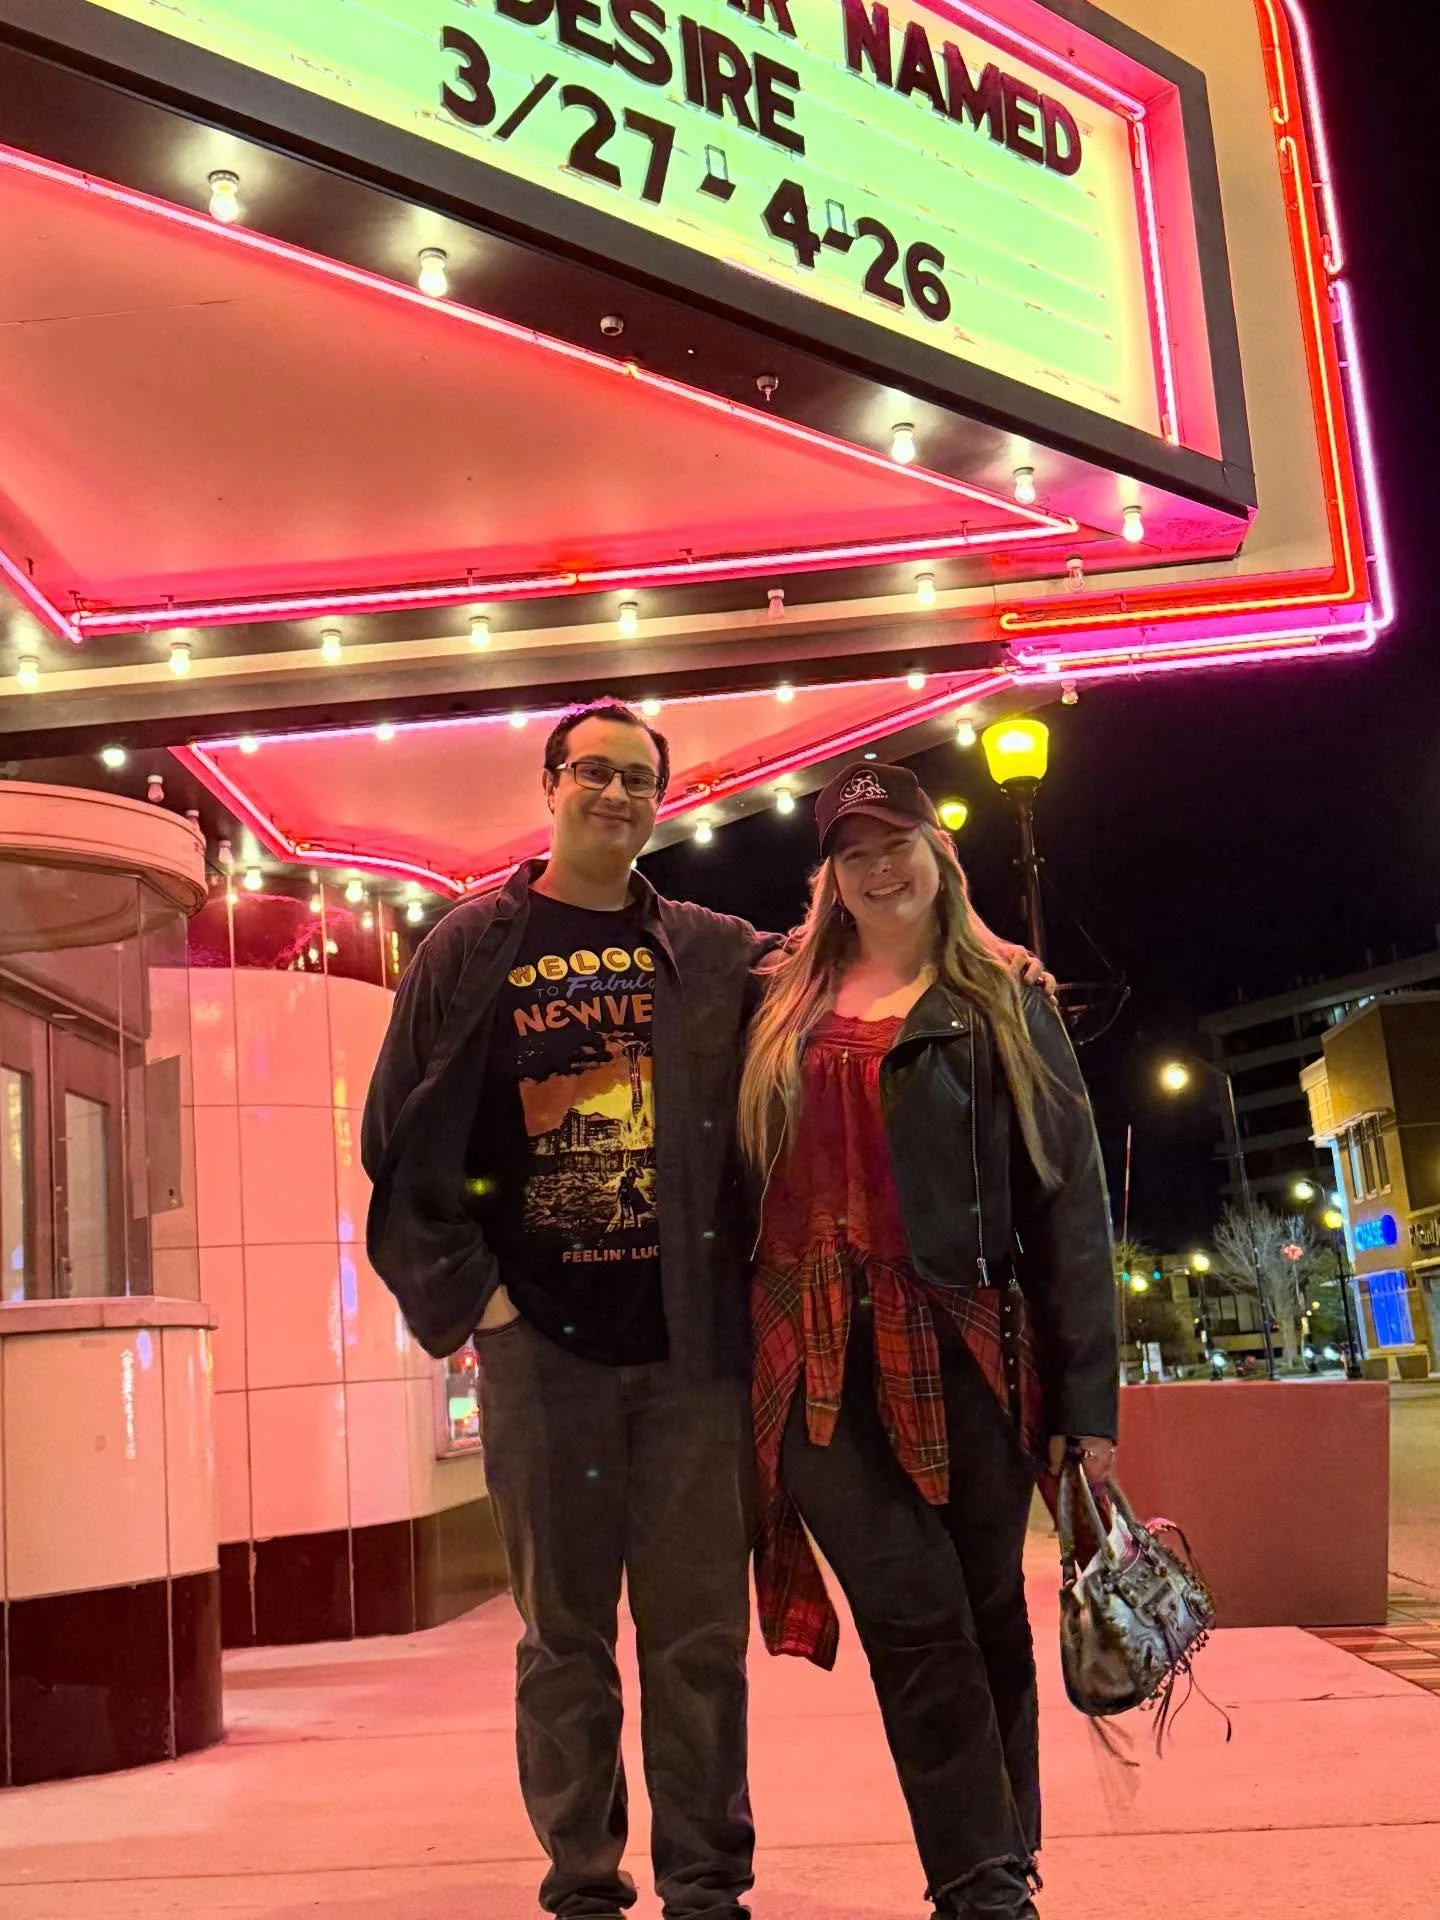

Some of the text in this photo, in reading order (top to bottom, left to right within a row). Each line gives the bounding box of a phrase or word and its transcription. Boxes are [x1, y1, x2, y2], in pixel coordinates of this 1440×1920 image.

[440, 25, 676, 205] 3/27
[842, 0, 1082, 176] NAMED
[535, 986, 559, 999] TO
